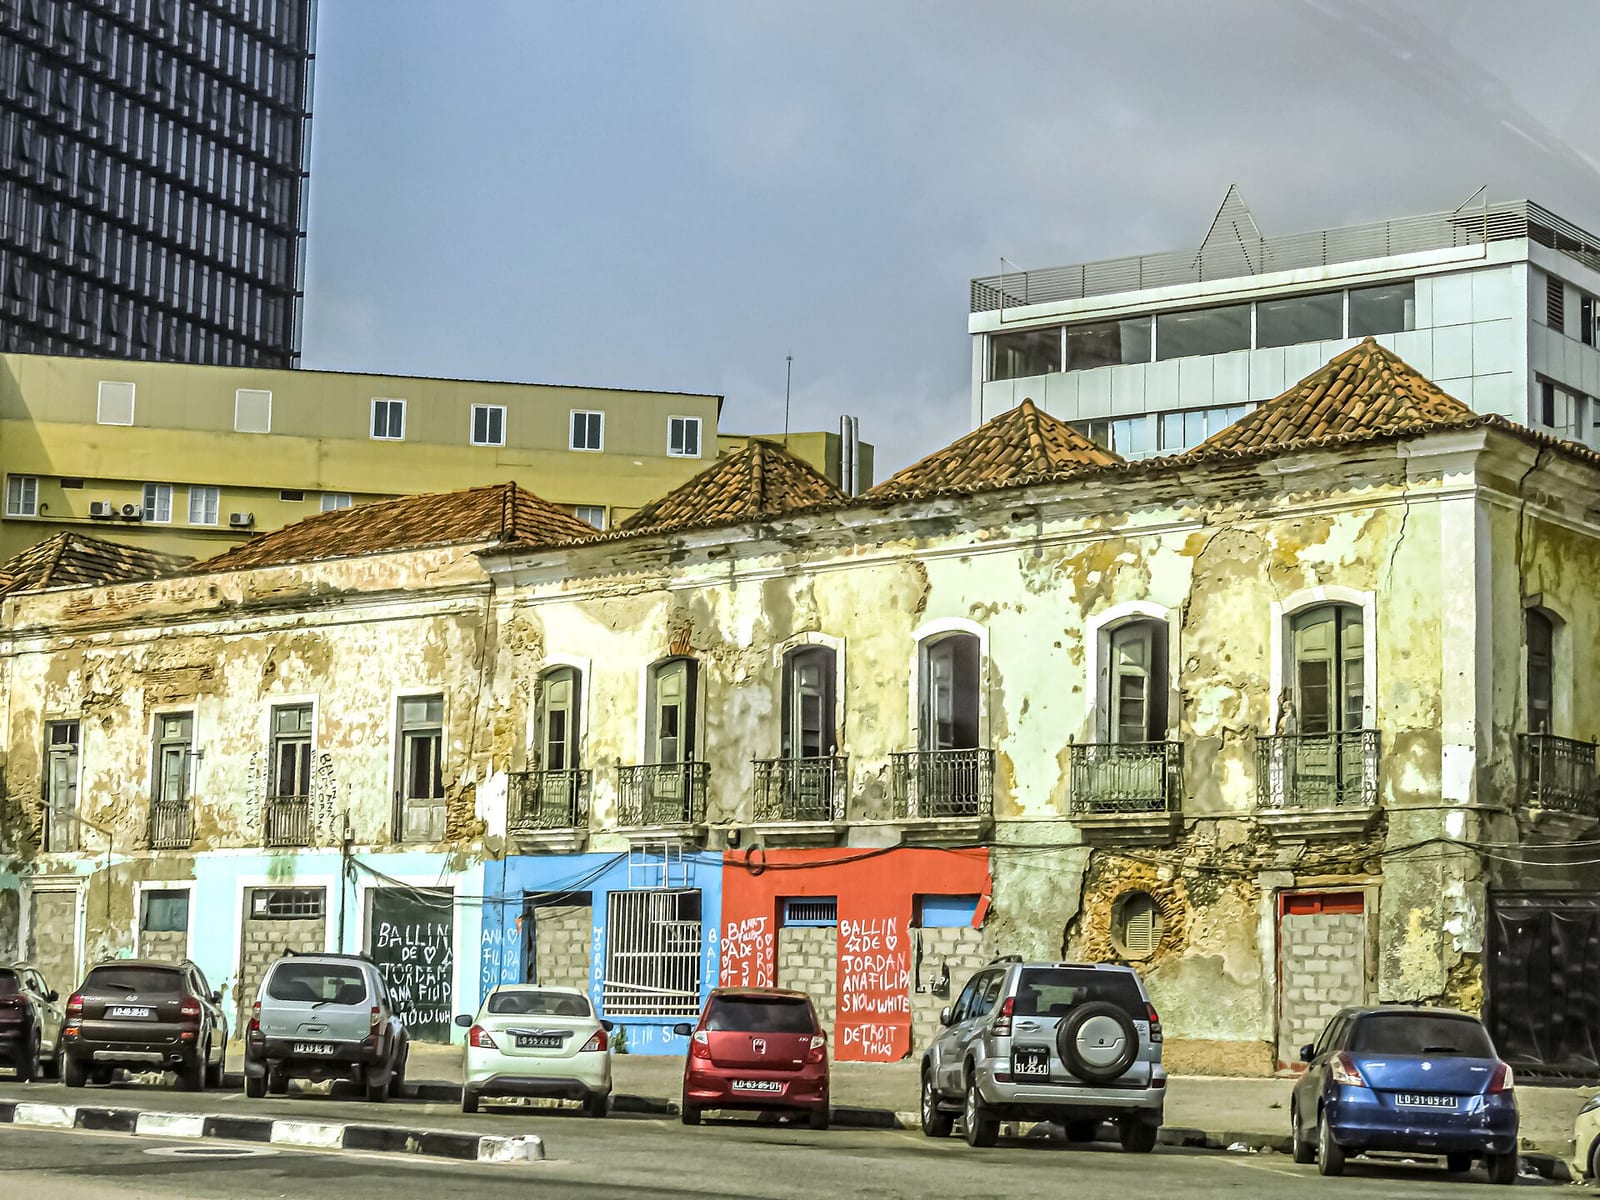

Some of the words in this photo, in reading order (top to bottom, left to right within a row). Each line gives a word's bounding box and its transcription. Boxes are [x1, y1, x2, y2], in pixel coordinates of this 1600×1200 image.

[377, 921, 450, 950] BALLIN
[840, 916, 898, 936] BALLIN
[401, 946, 418, 961] DE
[862, 936, 881, 952] DE
[482, 947, 520, 967] FILIPA
[592, 926, 604, 1004] JORDAN
[840, 951, 906, 974] JORDAN
[482, 966, 517, 983] SNOW
[841, 995, 876, 1014] SNOW
[877, 994, 911, 1014] WHITE
[843, 1023, 898, 1046] DETROIT
